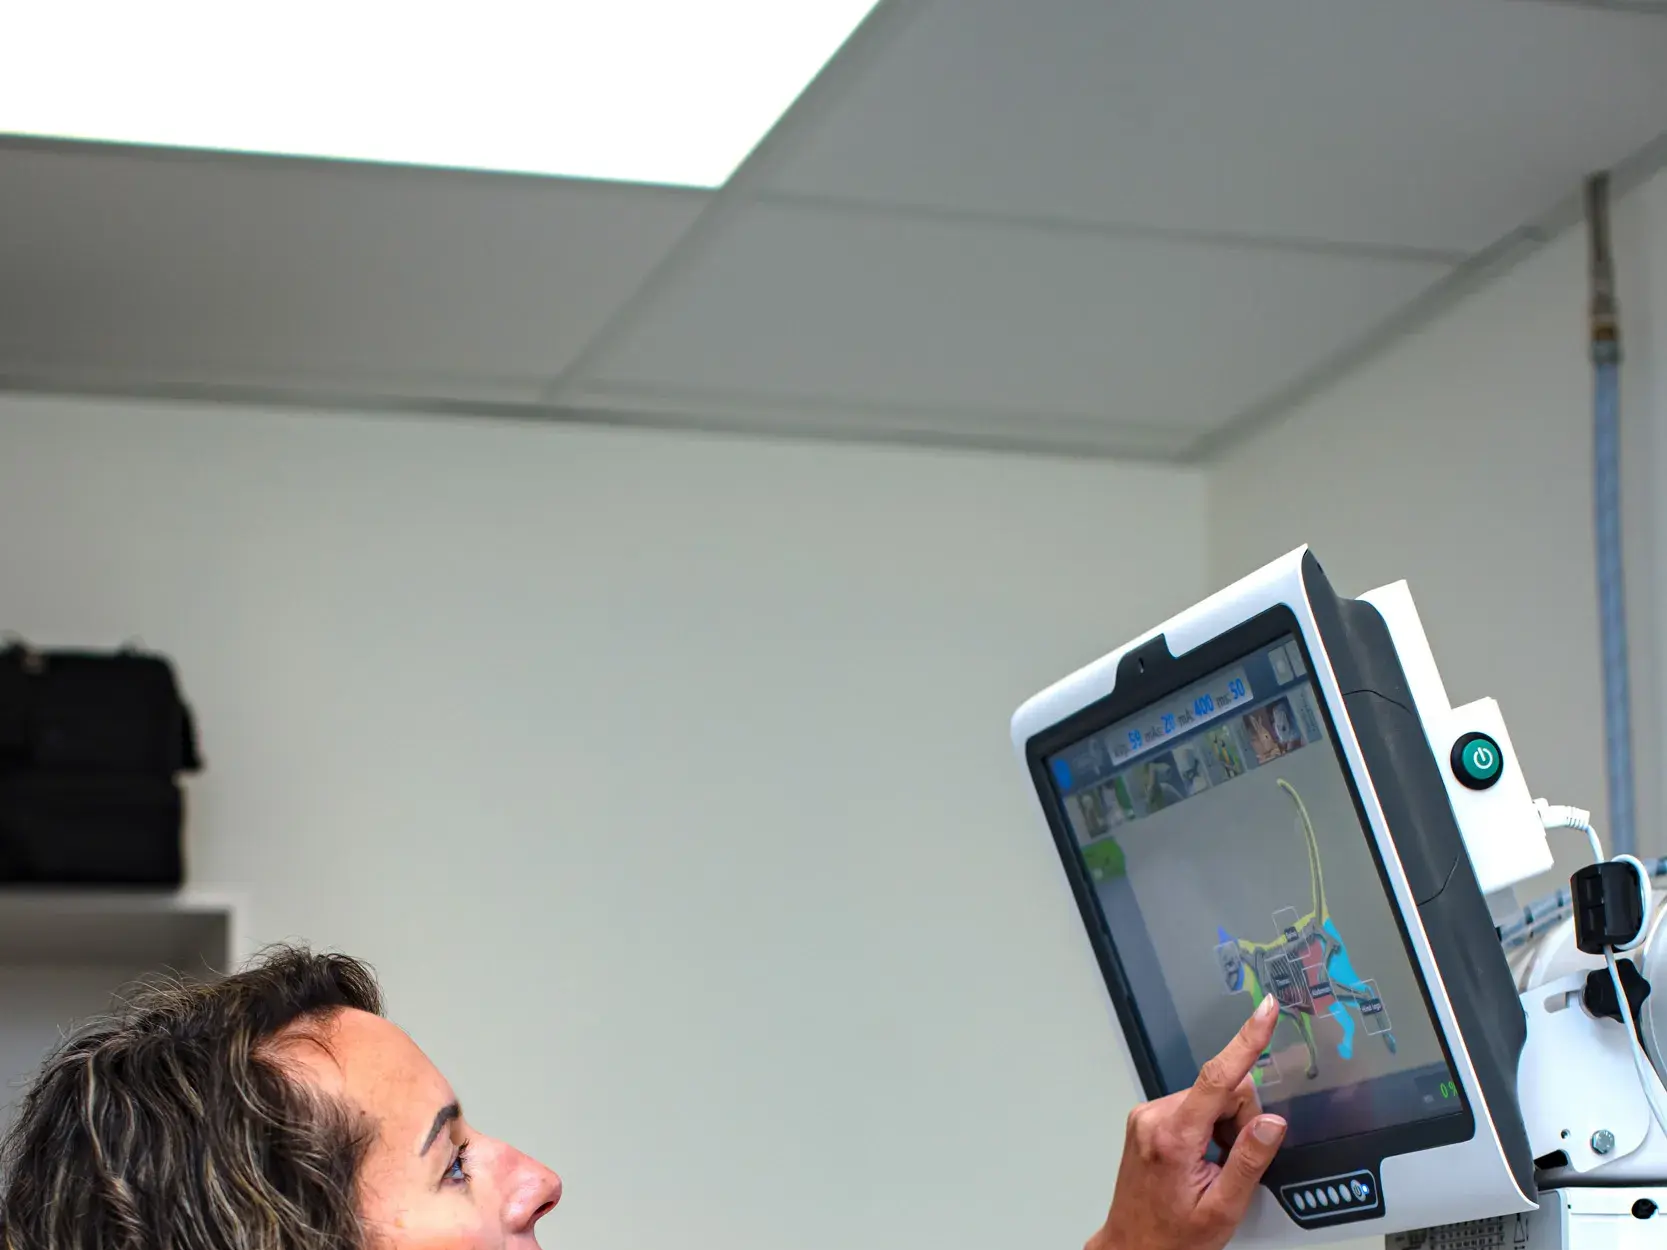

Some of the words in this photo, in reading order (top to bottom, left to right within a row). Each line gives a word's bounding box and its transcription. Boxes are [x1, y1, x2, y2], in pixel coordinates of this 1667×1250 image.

[1128, 729, 1142, 750] 59
[1194, 693, 1214, 716] 400
[1228, 678, 1246, 700] 50
